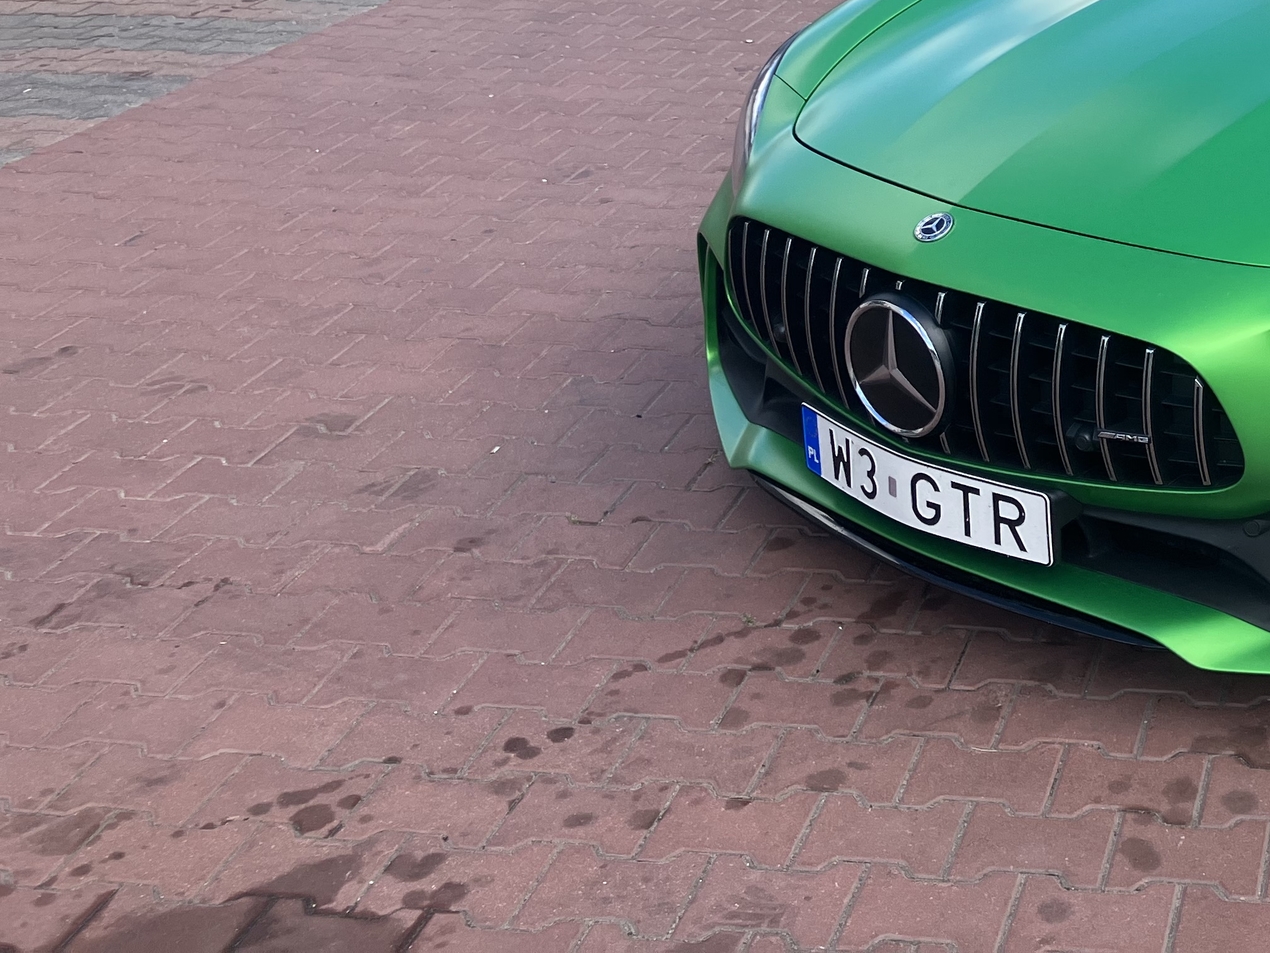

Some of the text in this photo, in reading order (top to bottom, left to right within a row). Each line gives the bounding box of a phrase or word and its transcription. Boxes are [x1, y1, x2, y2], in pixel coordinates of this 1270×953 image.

[807, 428, 1028, 553] PL W3 GTR
